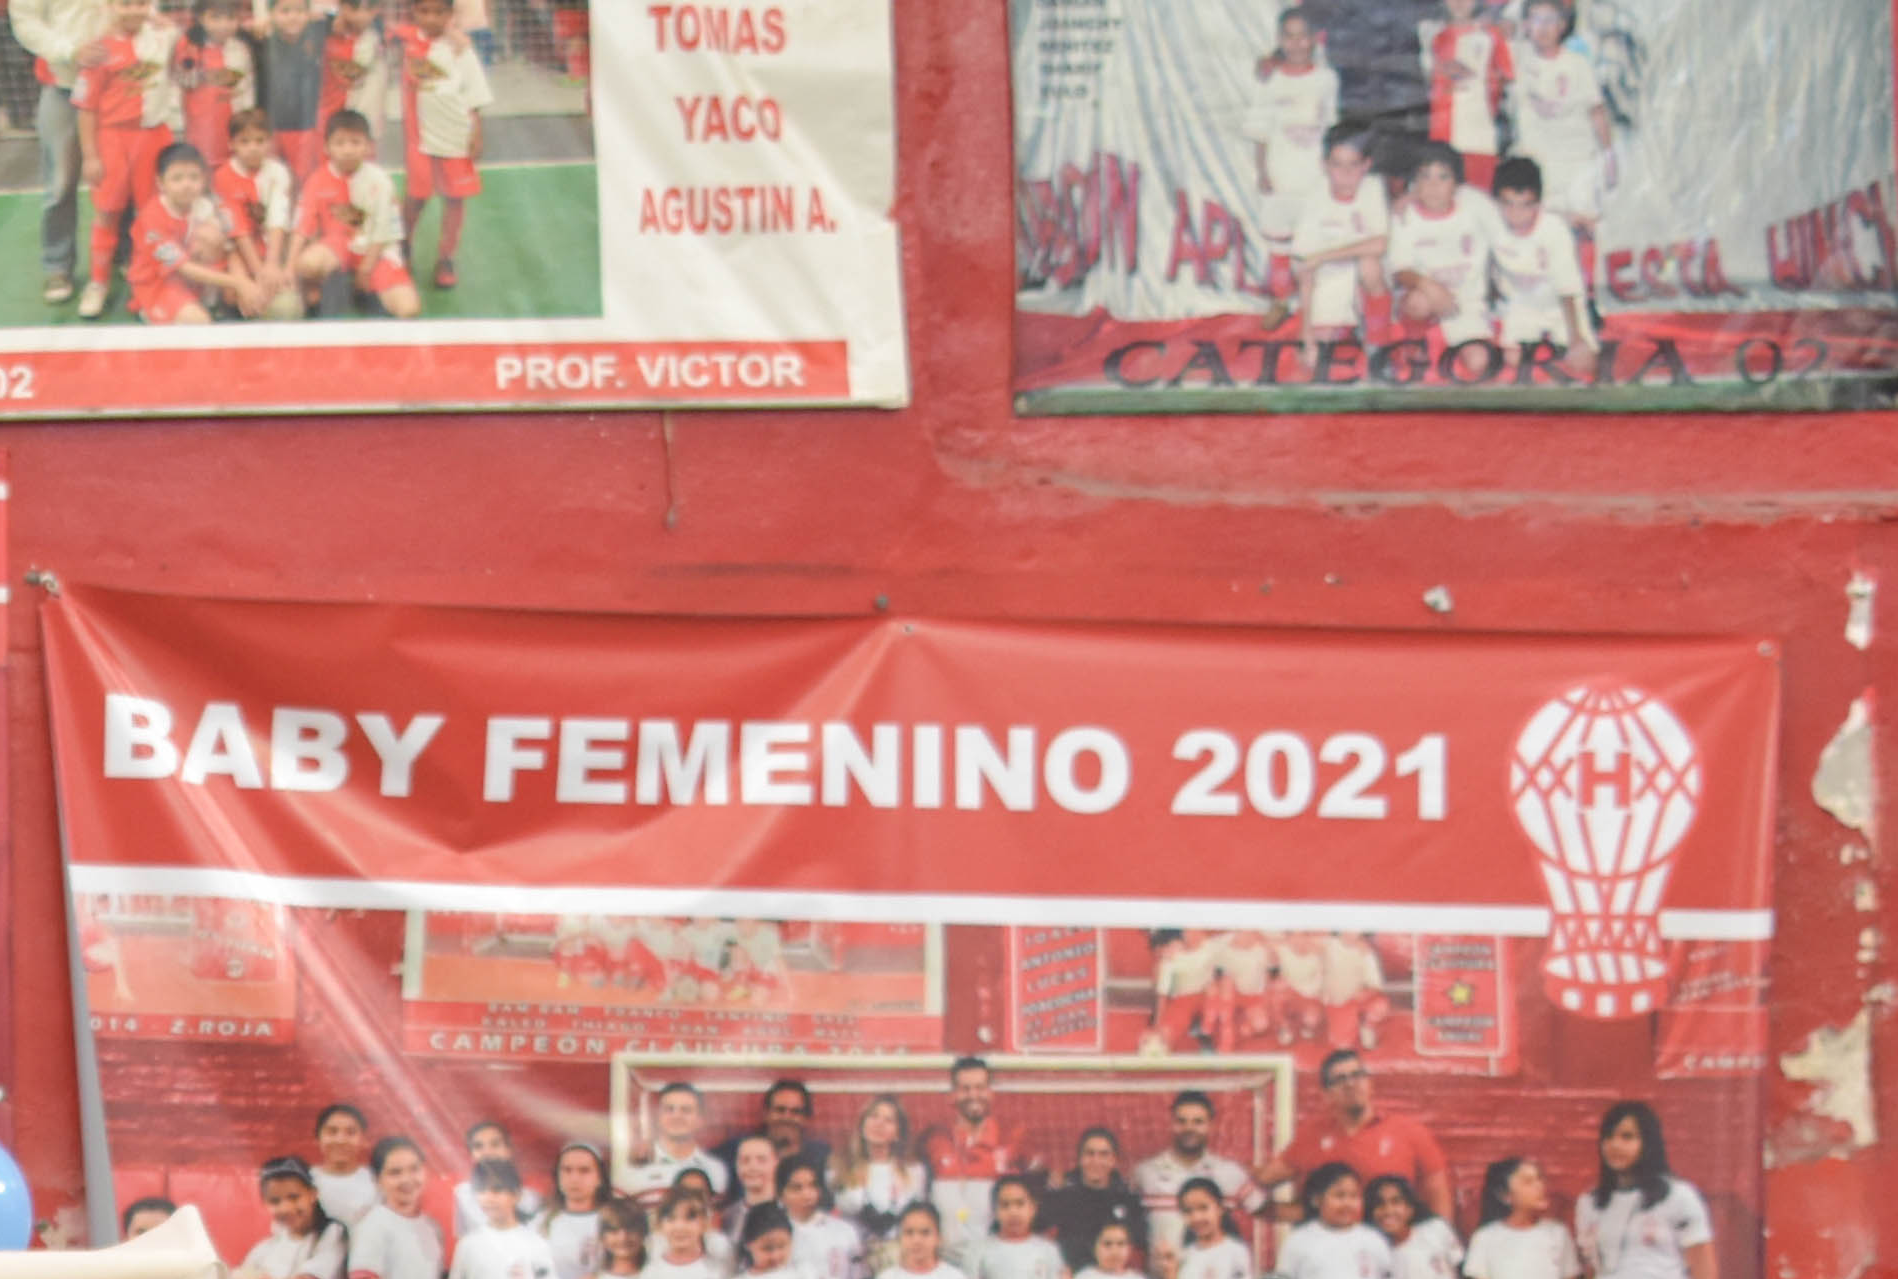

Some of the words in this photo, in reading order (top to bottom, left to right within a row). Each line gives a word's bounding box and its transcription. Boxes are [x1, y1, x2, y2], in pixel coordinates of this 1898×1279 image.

[647, 5, 786, 54] TOMAS
[675, 95, 784, 143] YACO
[639, 186, 795, 236] AGUSTIN
[807, 188, 838, 234] A.
[494, 355, 627, 391] PROF.
[635, 353, 806, 389] VICTOR
[1102, 337, 1700, 388] CATEGORIA
[103, 693, 445, 799] BABY
[482, 715, 1132, 815] FEMENINO
[1169, 727, 1448, 821] 2021
